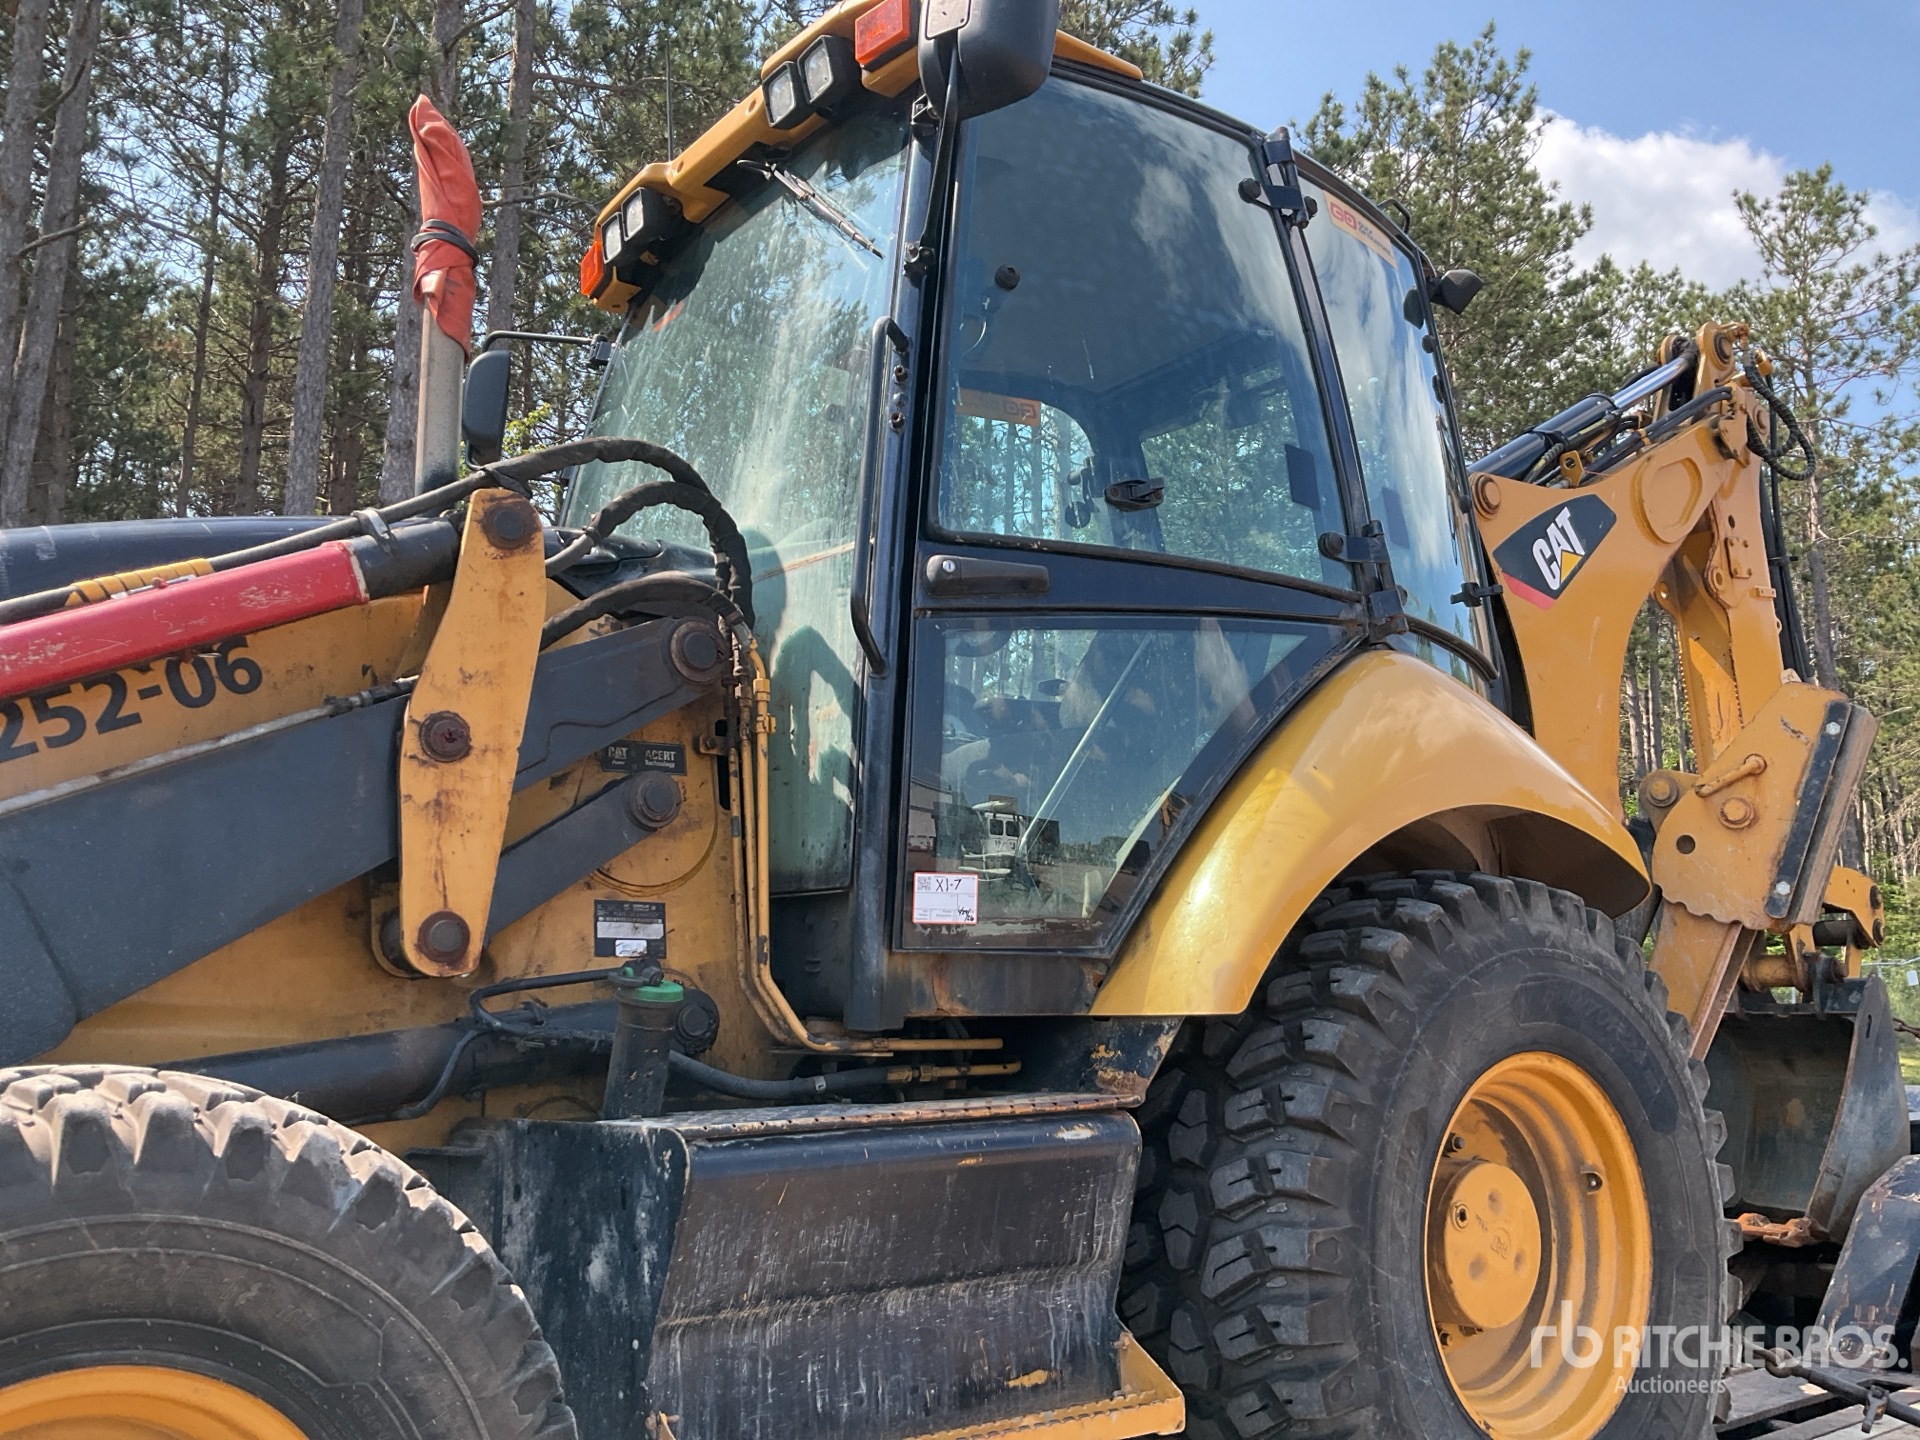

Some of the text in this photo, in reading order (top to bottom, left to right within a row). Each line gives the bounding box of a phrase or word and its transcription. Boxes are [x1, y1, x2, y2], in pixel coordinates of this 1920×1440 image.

[1532, 506, 1585, 590] CAT
[608, 746, 628, 759] CAT
[645, 750, 676, 761] ACERT
[645, 760, 675, 768] Technology
